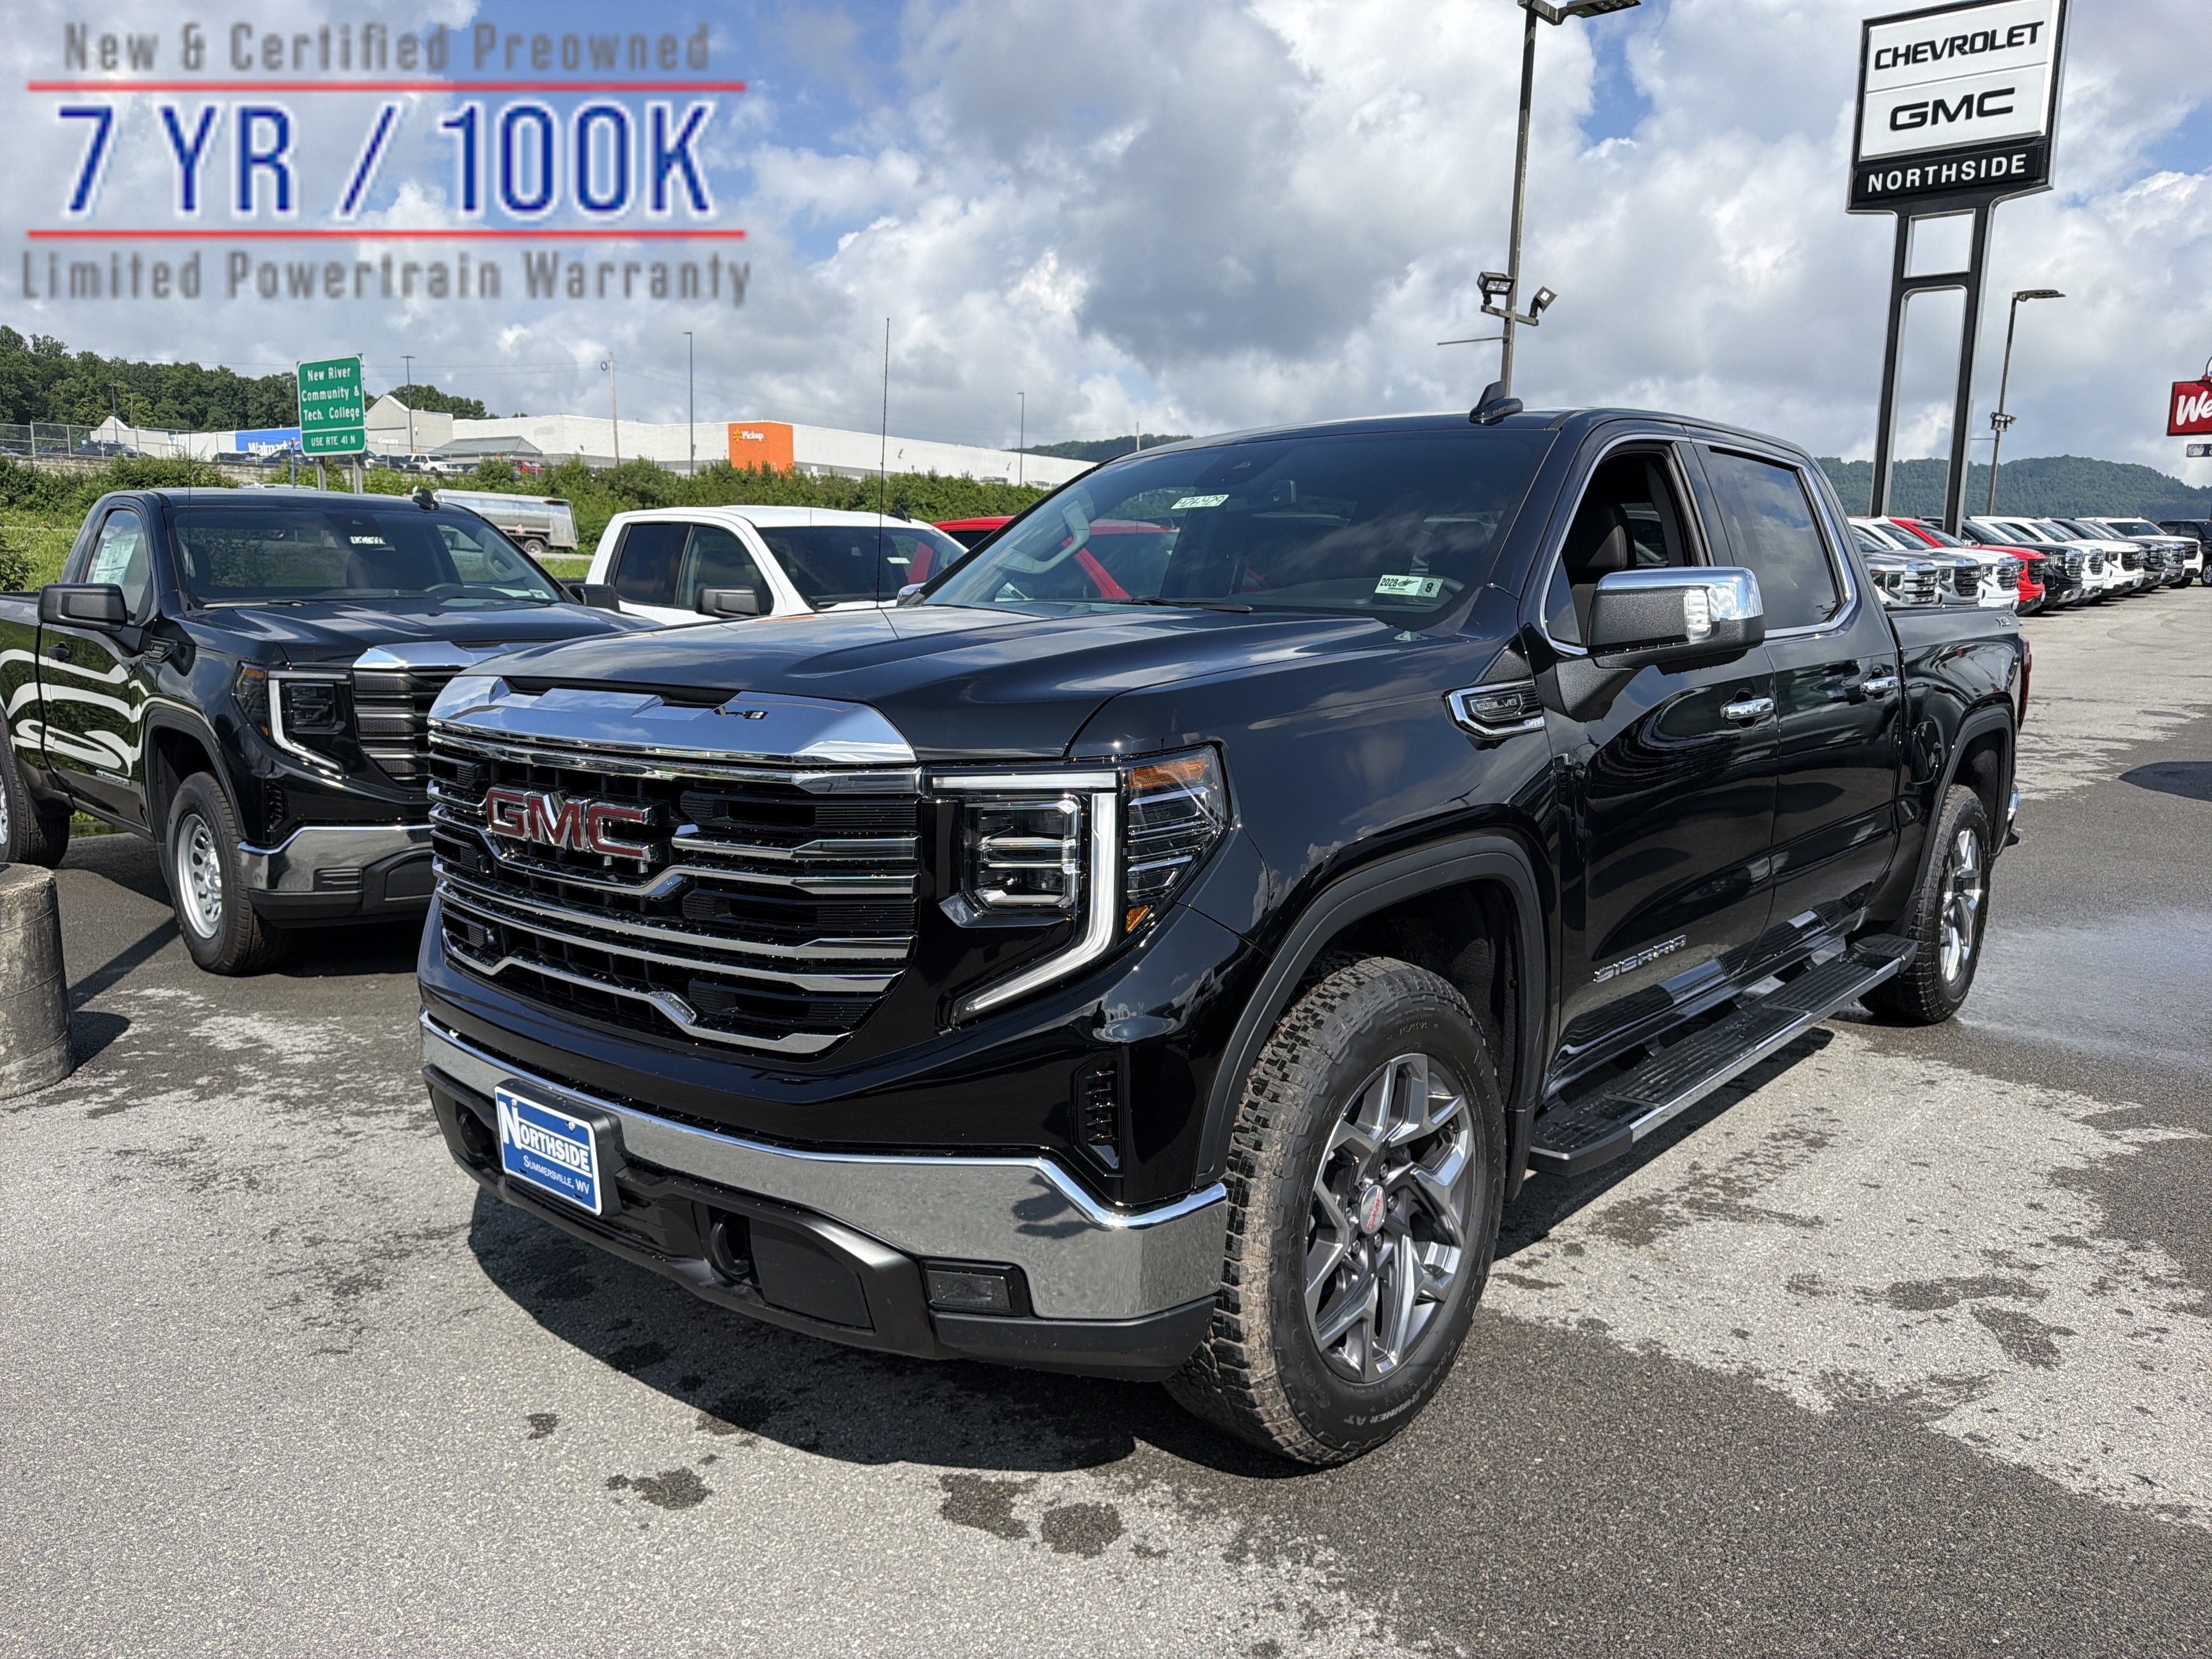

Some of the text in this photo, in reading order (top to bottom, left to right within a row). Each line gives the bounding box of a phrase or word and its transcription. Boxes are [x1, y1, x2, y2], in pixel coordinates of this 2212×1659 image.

[1874, 20, 2045, 71] CHEVROLET
[1889, 87, 2016, 131] GMC
[1867, 153, 2027, 194] NORTHSIDE
[307, 366, 351, 382] New River
[302, 385, 360, 402] Community &
[329, 406, 360, 421] College
[247, 439, 288, 456] Walmart
[311, 435, 356, 447] USE RTE 41 N
[1379, 578, 1399, 587] 2028
[1425, 582, 1434, 593] 8
[486, 784, 653, 862] GMC
[1593, 934, 1686, 983] SIERRA
[498, 1101, 590, 1172] NORTHSIDE
[575, 1178, 590, 1194] WV
